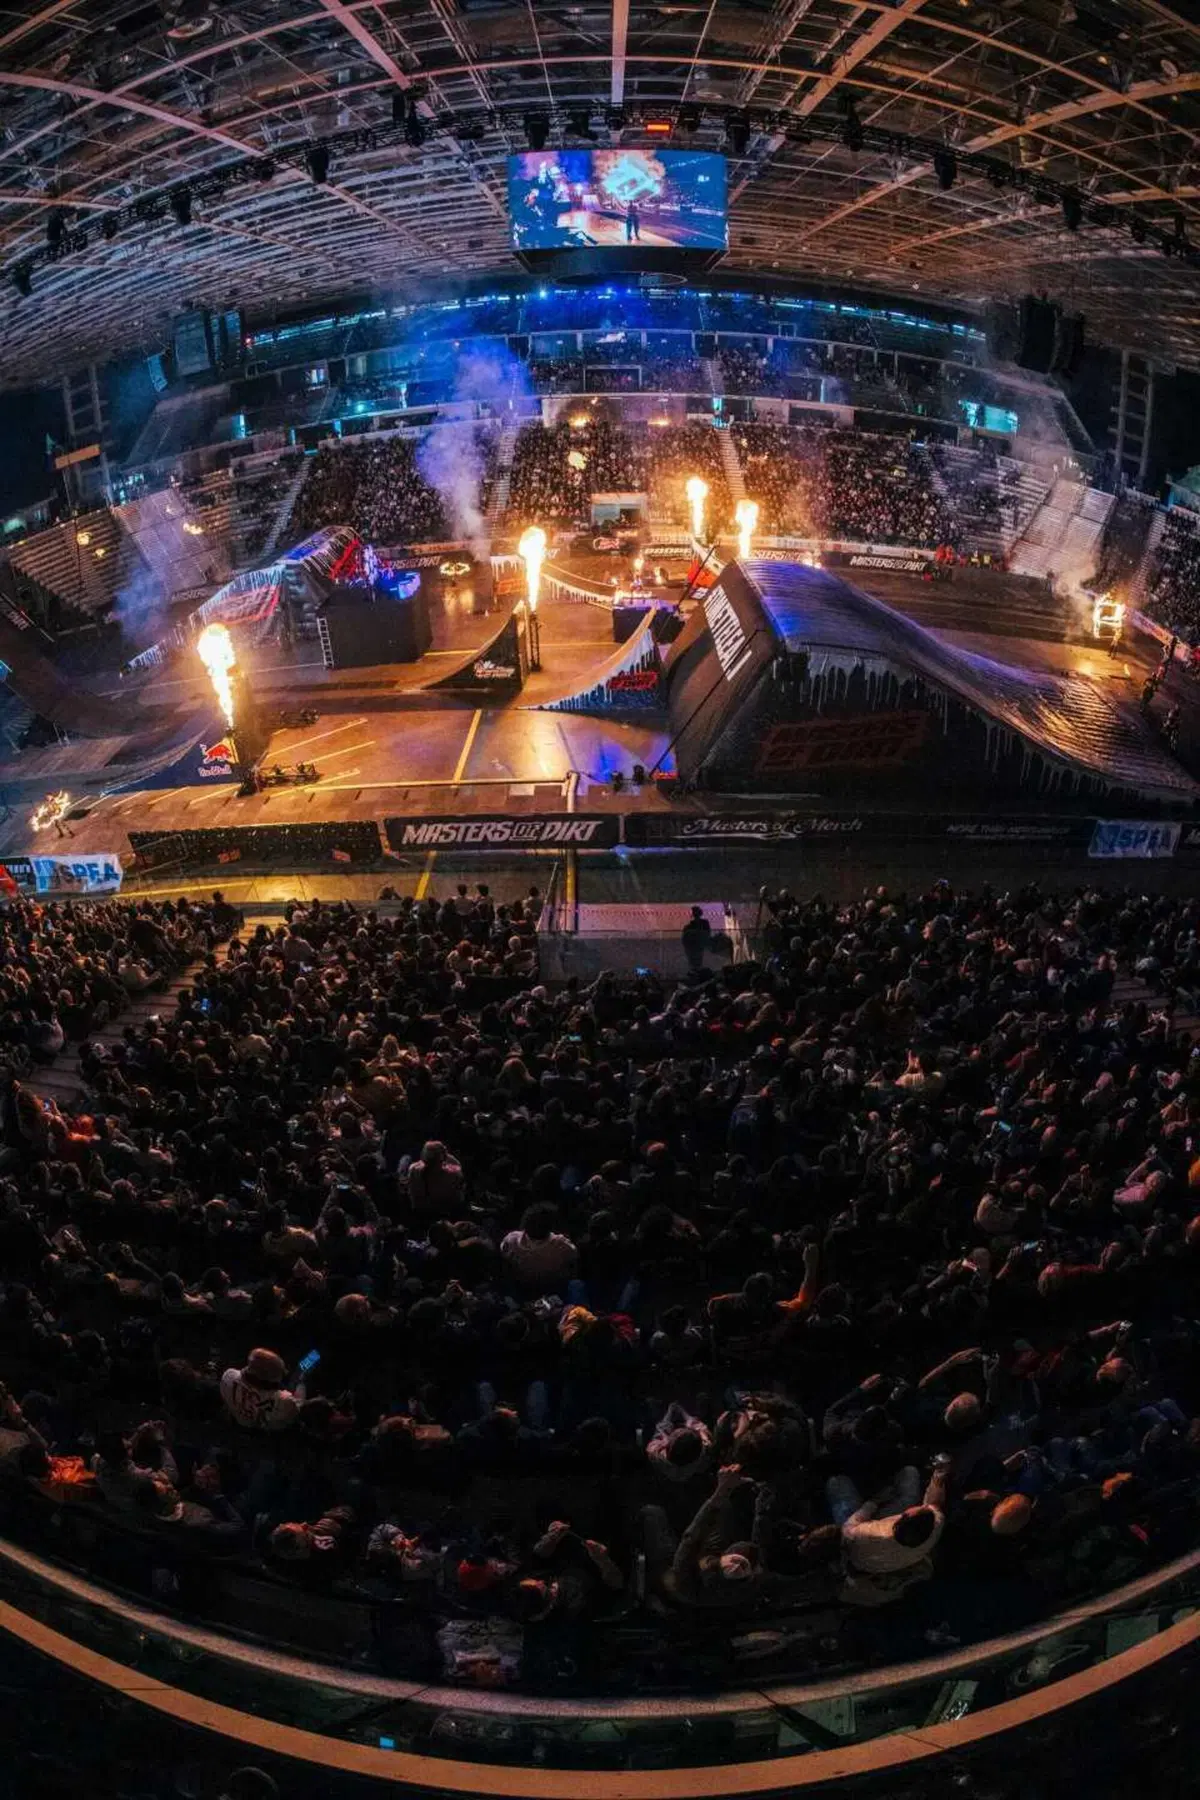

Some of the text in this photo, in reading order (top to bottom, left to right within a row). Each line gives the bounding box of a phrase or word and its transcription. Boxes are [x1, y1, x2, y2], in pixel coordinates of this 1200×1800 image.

[850, 555, 894, 569] MASTERS
[904, 560, 928, 571] DIRT
[402, 822, 514, 845] MASTERS
[540, 821, 605, 841] DIRT
[683, 818, 769, 835] Masters
[792, 818, 864, 834] Merch
